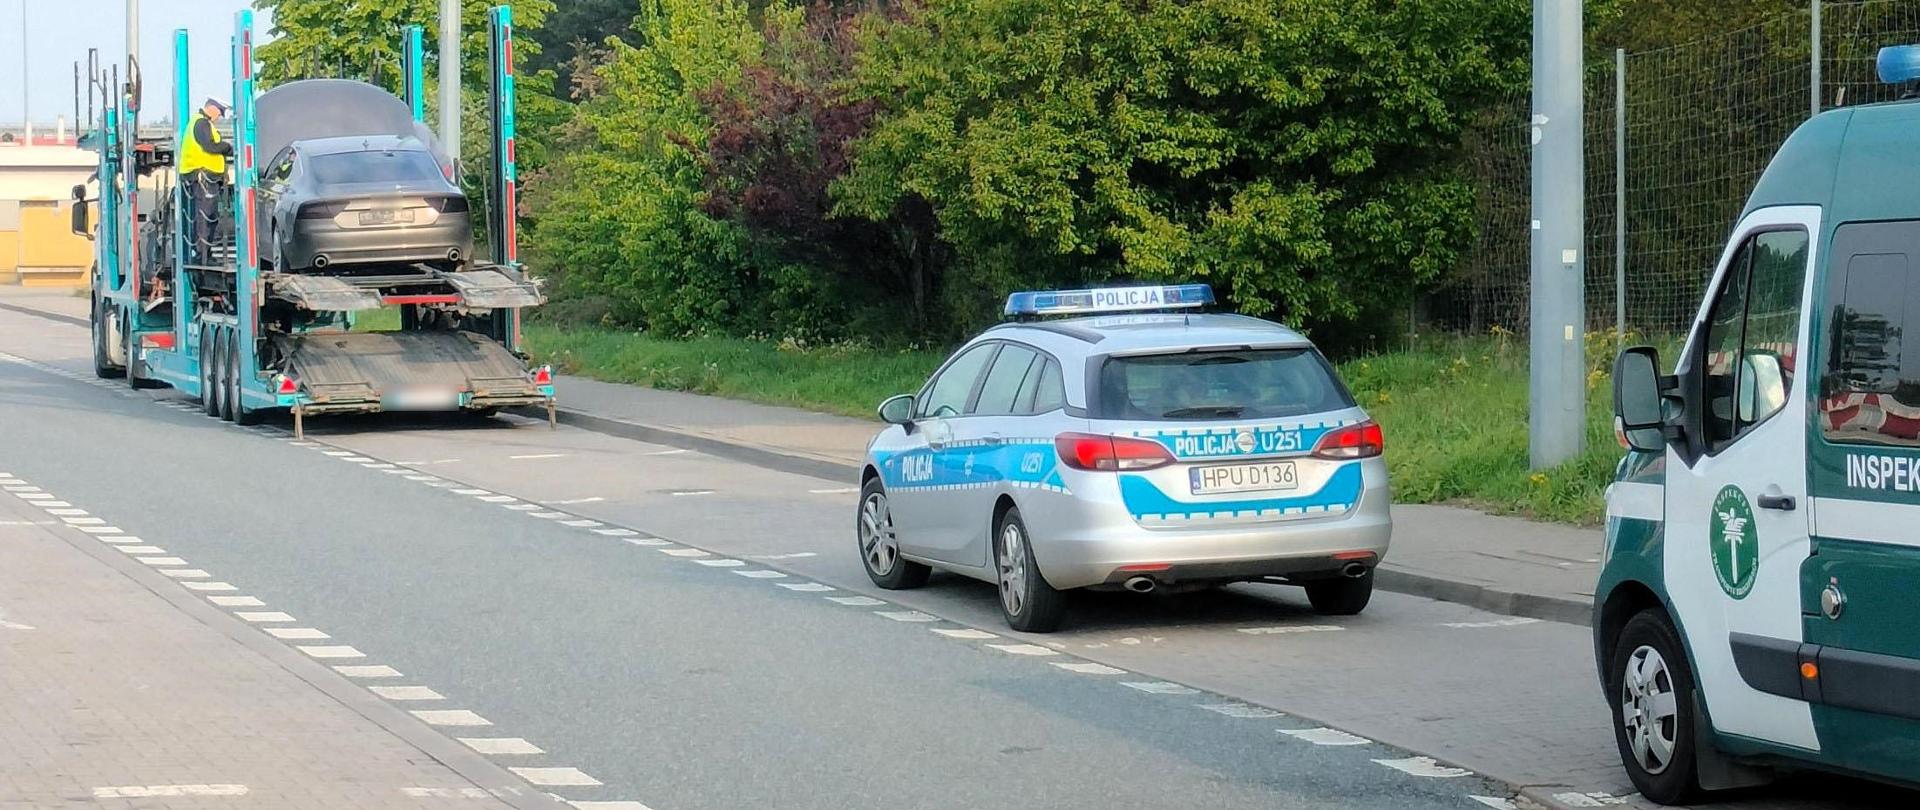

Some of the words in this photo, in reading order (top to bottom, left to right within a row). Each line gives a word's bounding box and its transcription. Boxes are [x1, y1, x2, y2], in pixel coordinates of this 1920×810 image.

[1096, 290, 1160, 306] POLICJA
[1175, 434, 1237, 456] POLICJA
[1261, 430, 1303, 451] U251
[902, 453, 934, 483] POLICJA
[1020, 452, 1044, 473] U251
[1847, 453, 1920, 492] INSPEK
[1203, 467, 1244, 488] HPU
[1249, 464, 1294, 485] D136
